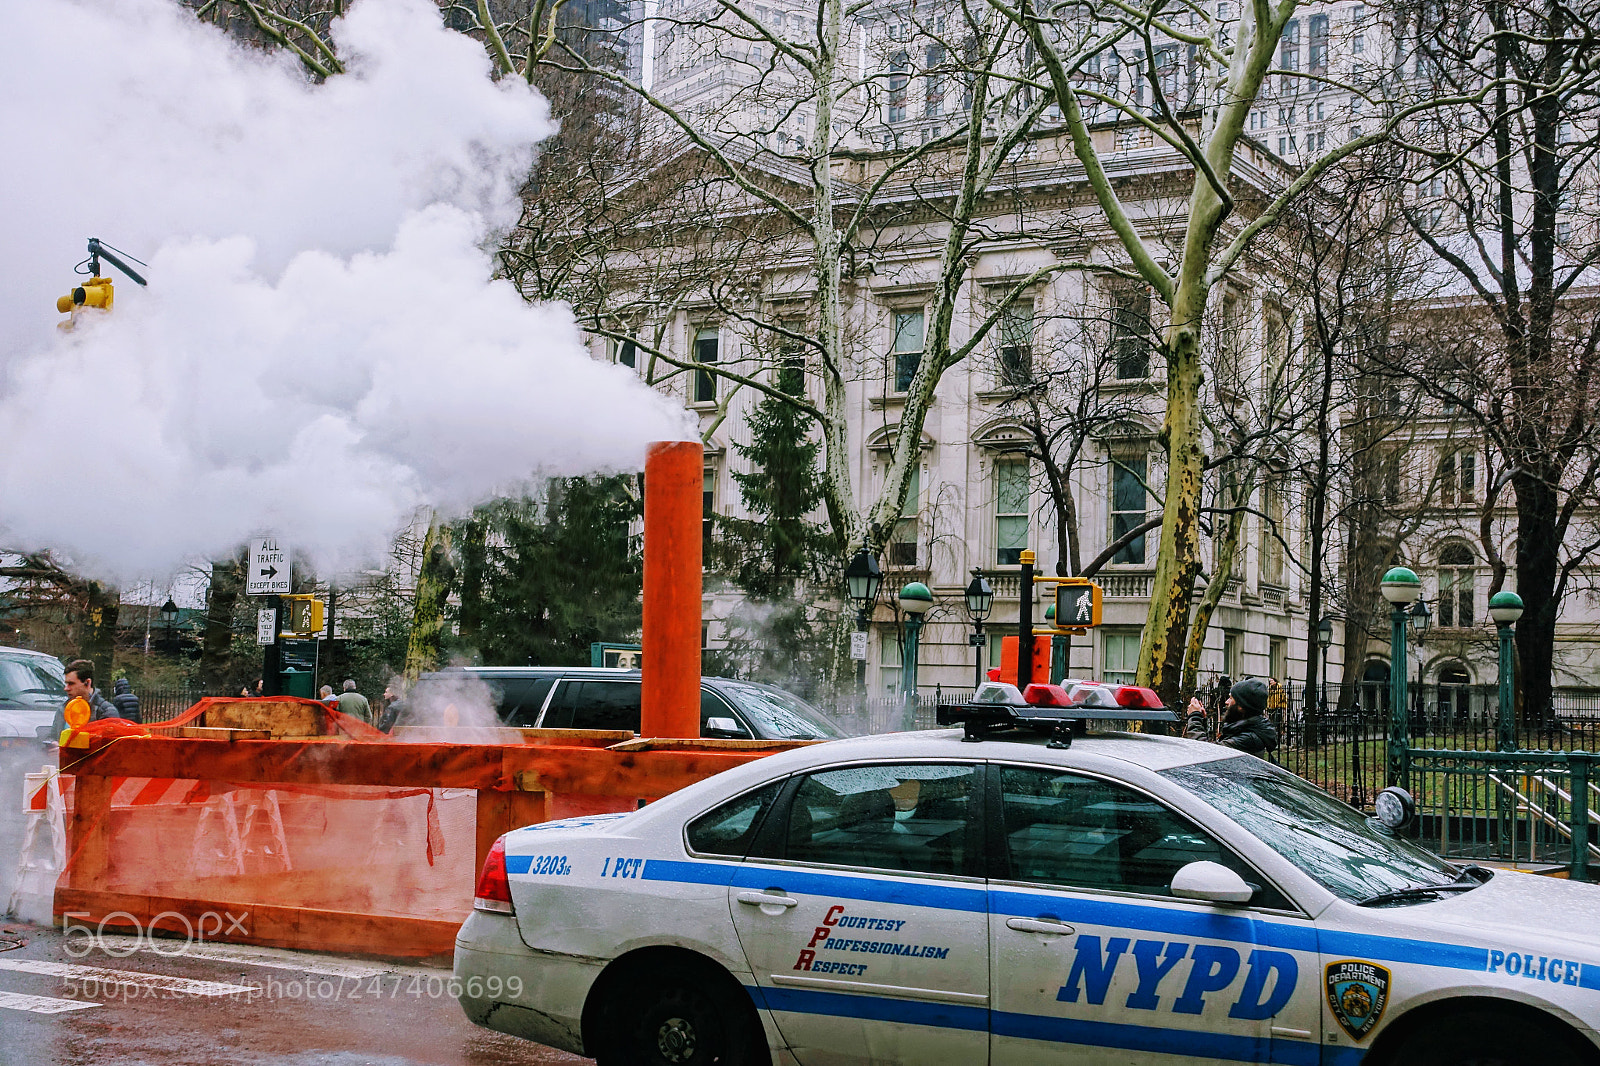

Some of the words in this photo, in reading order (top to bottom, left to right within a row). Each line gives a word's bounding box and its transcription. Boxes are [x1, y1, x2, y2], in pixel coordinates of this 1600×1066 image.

[261, 539, 280, 551] ALL
[257, 553, 284, 563] TRAFFIC
[271, 581, 288, 589] BIKES
[532, 855, 567, 875] 3203
[612, 857, 643, 879] PCT
[822, 905, 906, 932] COURTESY
[807, 926, 950, 960] PROFESSIONALISM
[793, 949, 868, 976] RESPECT
[1341, 964, 1376, 975] POLICE
[1488, 949, 1579, 987] POLICE
[1056, 935, 1298, 1020] NYPD
[1329, 972, 1386, 989] DEPARTMENT
[1329, 994, 1342, 1014] CITY
[1339, 1016, 1351, 1027] OF
[1361, 1016, 1375, 1033] NEW
[1374, 993, 1385, 1015] YORK
